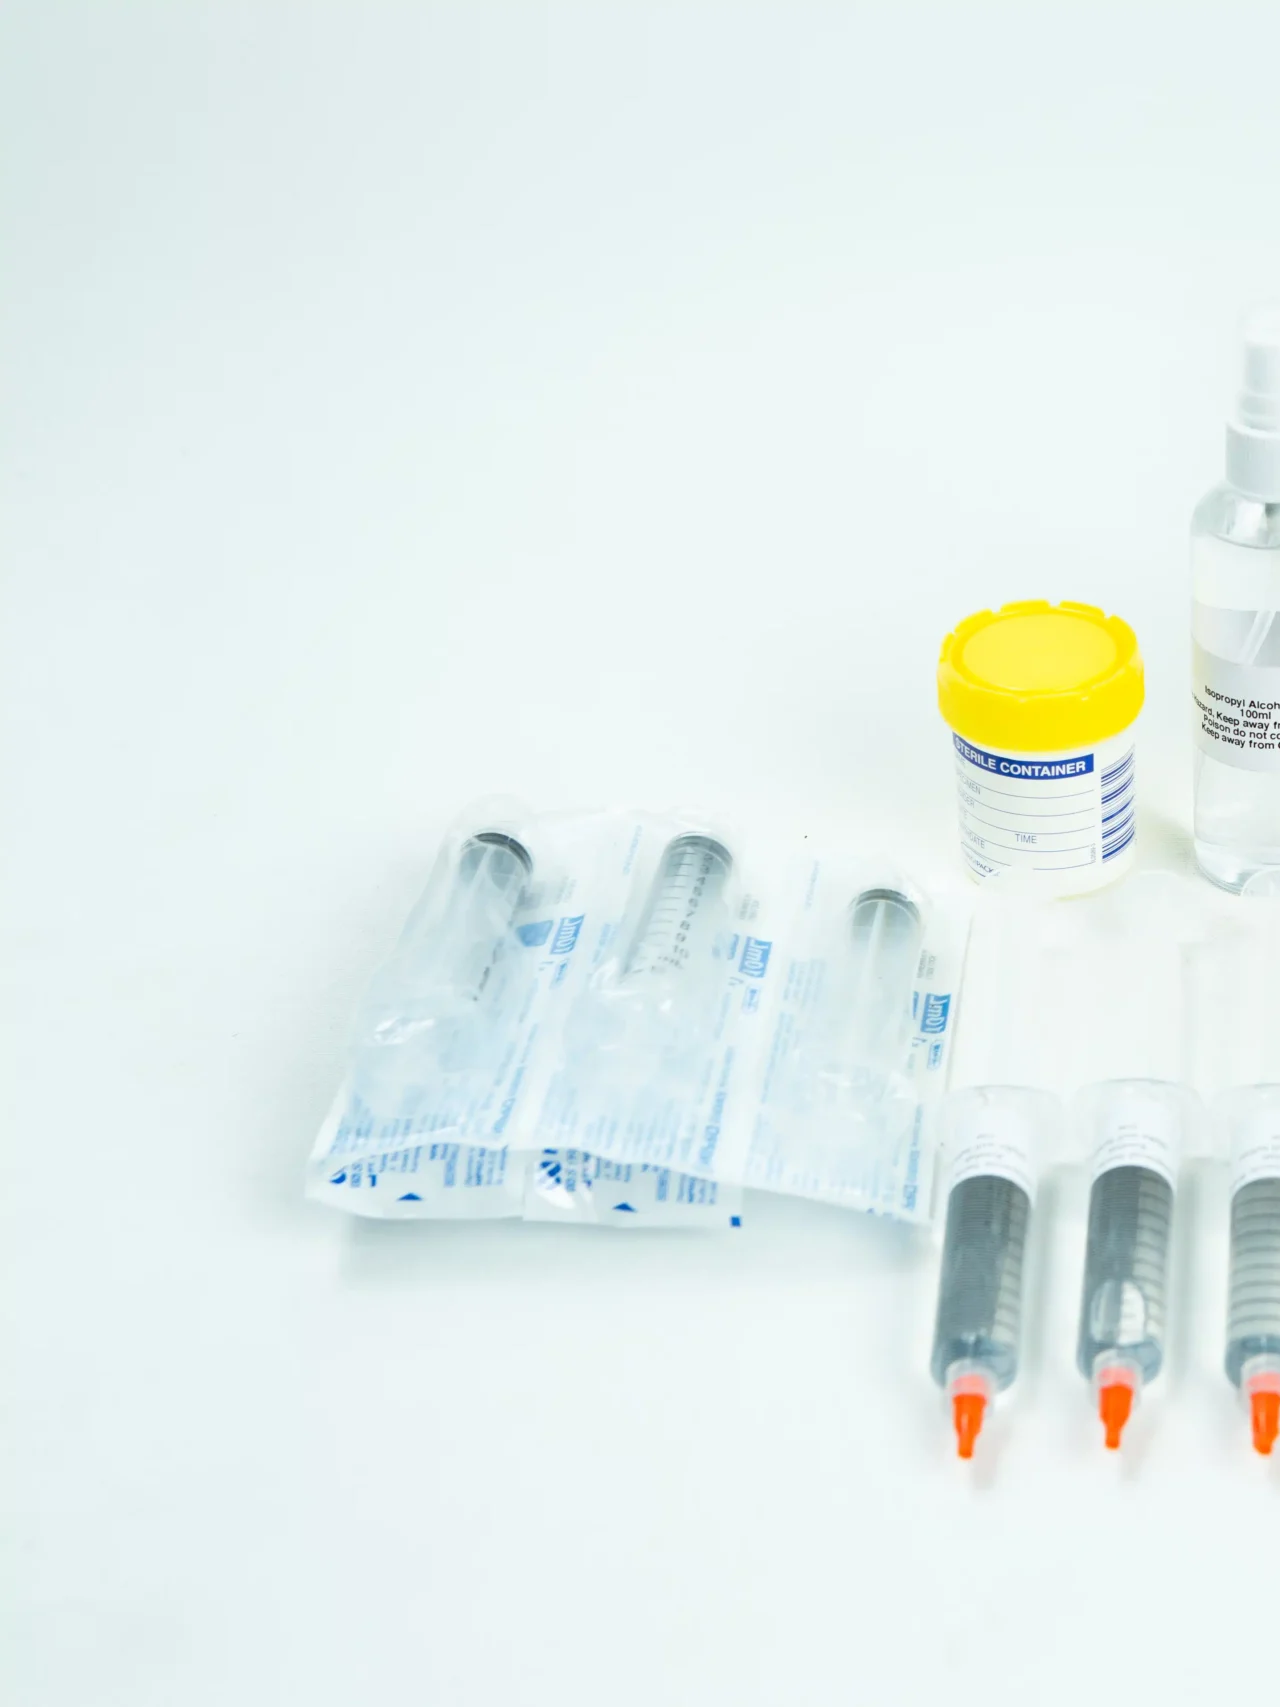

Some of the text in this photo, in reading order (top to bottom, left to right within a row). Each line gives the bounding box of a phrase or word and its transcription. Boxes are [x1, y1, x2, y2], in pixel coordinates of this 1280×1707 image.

[1204, 685, 1246, 708] Isopropyl
[1216, 711, 1240, 727] Keep
[1243, 720, 1270, 731] away
[1240, 709, 1271, 720] 100ml
[1201, 721, 1220, 740] Keep
[1221, 735, 1246, 749] away
[1249, 740, 1275, 749] from
[1203, 714, 1231, 733] Poison
[1233, 727, 1246, 737] do
[1249, 731, 1267, 740] not
[955, 737, 997, 771] STERILE
[1000, 761, 1086, 777] CONTAINER
[1015, 833, 1038, 844] TIME
